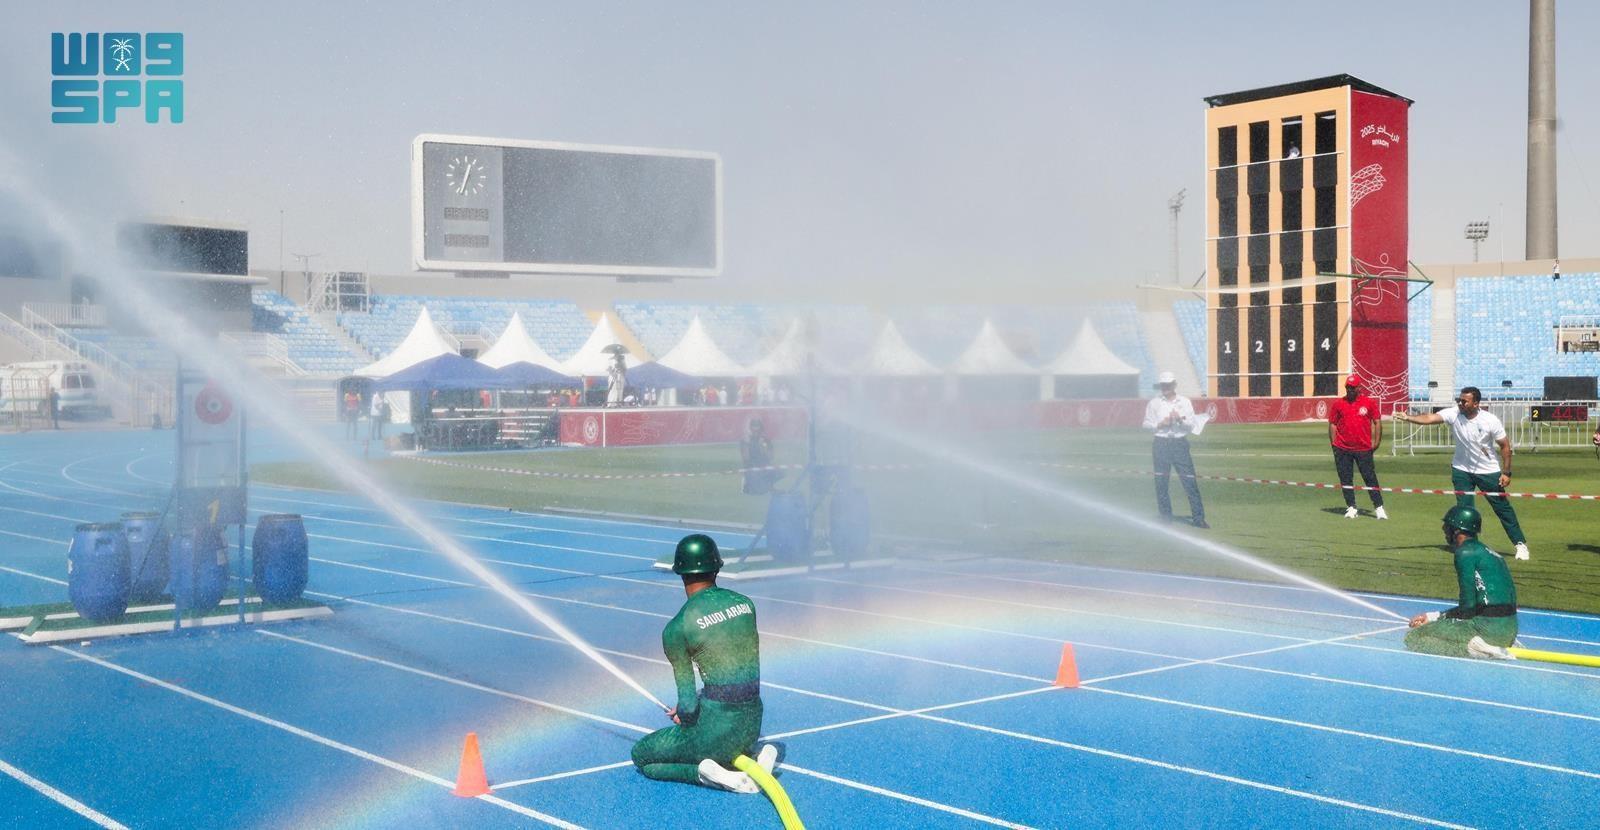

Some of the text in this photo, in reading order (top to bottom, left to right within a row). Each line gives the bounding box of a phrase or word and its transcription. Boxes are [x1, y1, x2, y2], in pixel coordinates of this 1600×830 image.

[1360, 124, 1376, 138] 2025
[1224, 341, 1232, 353] 1
[1255, 340, 1264, 353] 2
[1287, 339, 1296, 352] 3
[1320, 337, 1331, 351] 4
[1532, 409, 1539, 418] 2
[207, 499, 220, 524] 1
[696, 610, 727, 630] SAUDI
